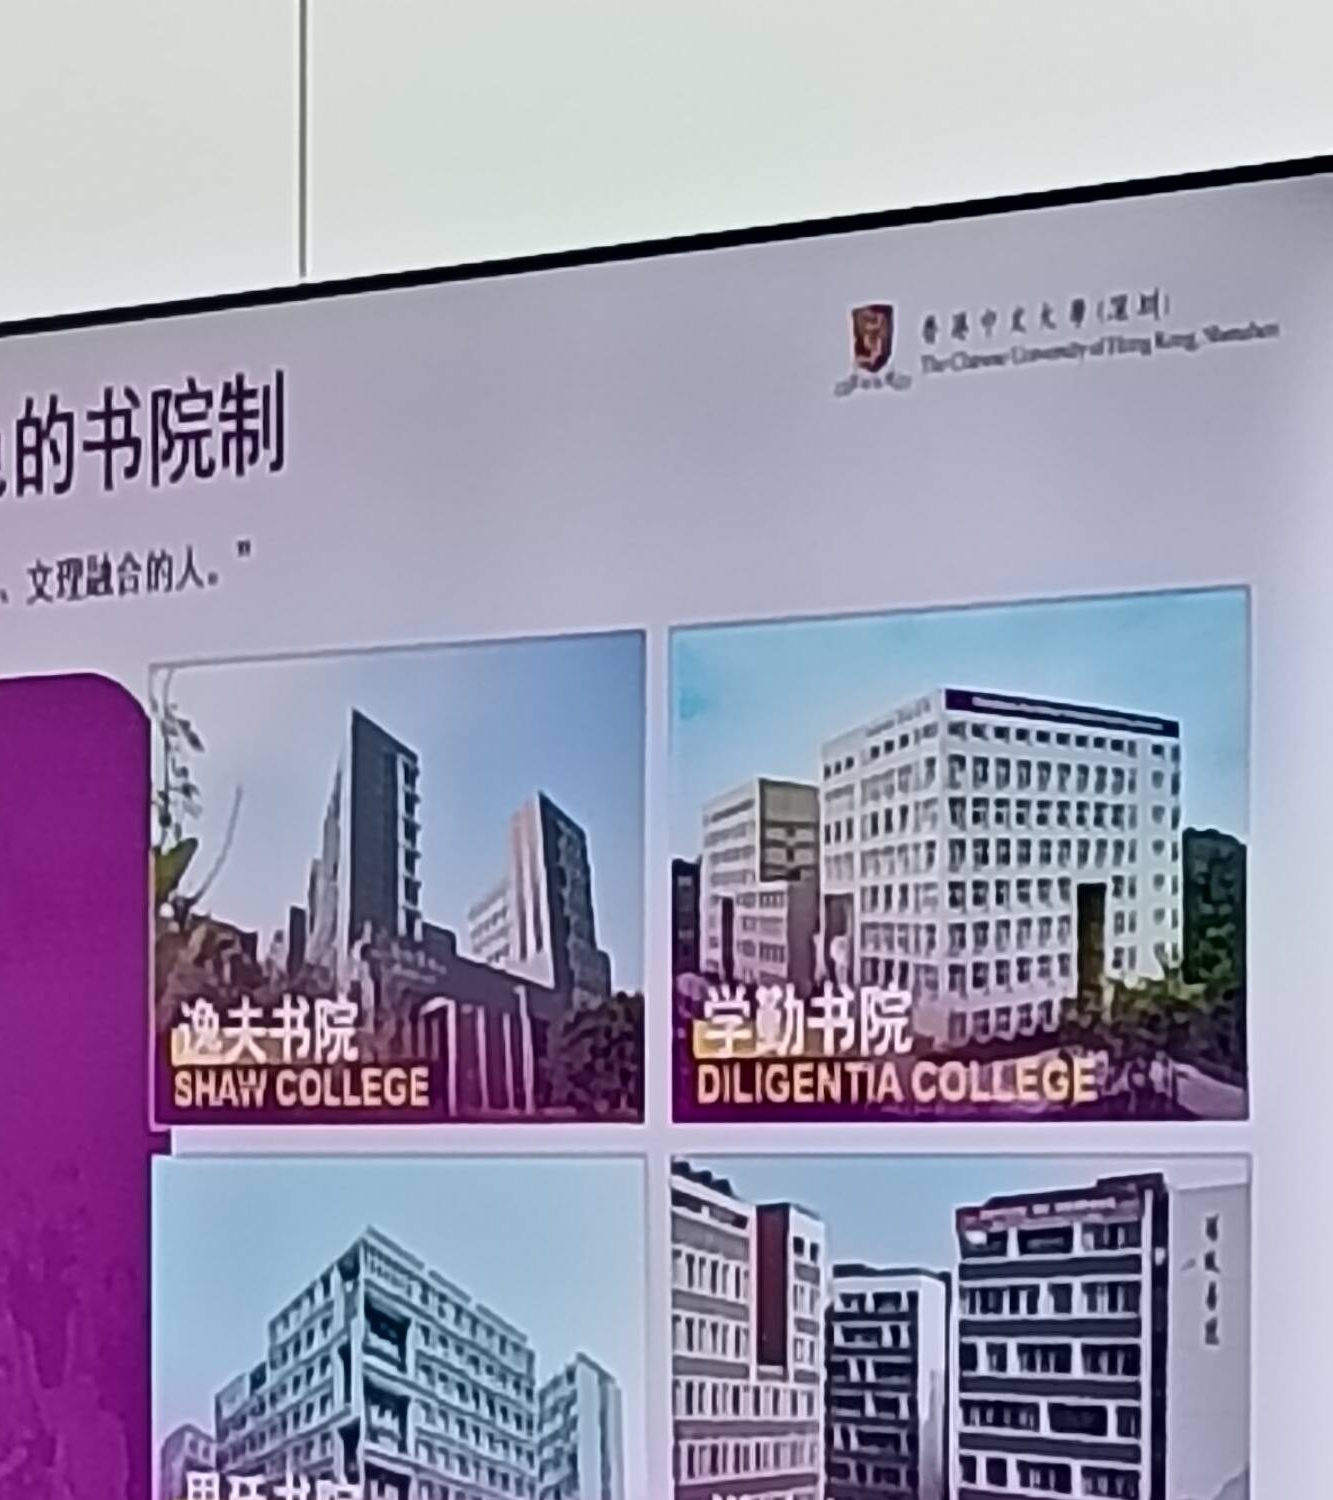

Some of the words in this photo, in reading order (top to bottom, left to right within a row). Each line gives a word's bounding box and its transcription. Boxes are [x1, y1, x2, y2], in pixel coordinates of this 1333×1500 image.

[177, 994, 359, 1064] 逸夫书院
[702, 983, 913, 1057] 学勤书院
[173, 1066, 267, 1109] SHAW
[275, 1066, 430, 1107] COLLEGE
[697, 1060, 903, 1105] DILIGENTIA
[910, 1056, 1100, 1104] COLLEGE
